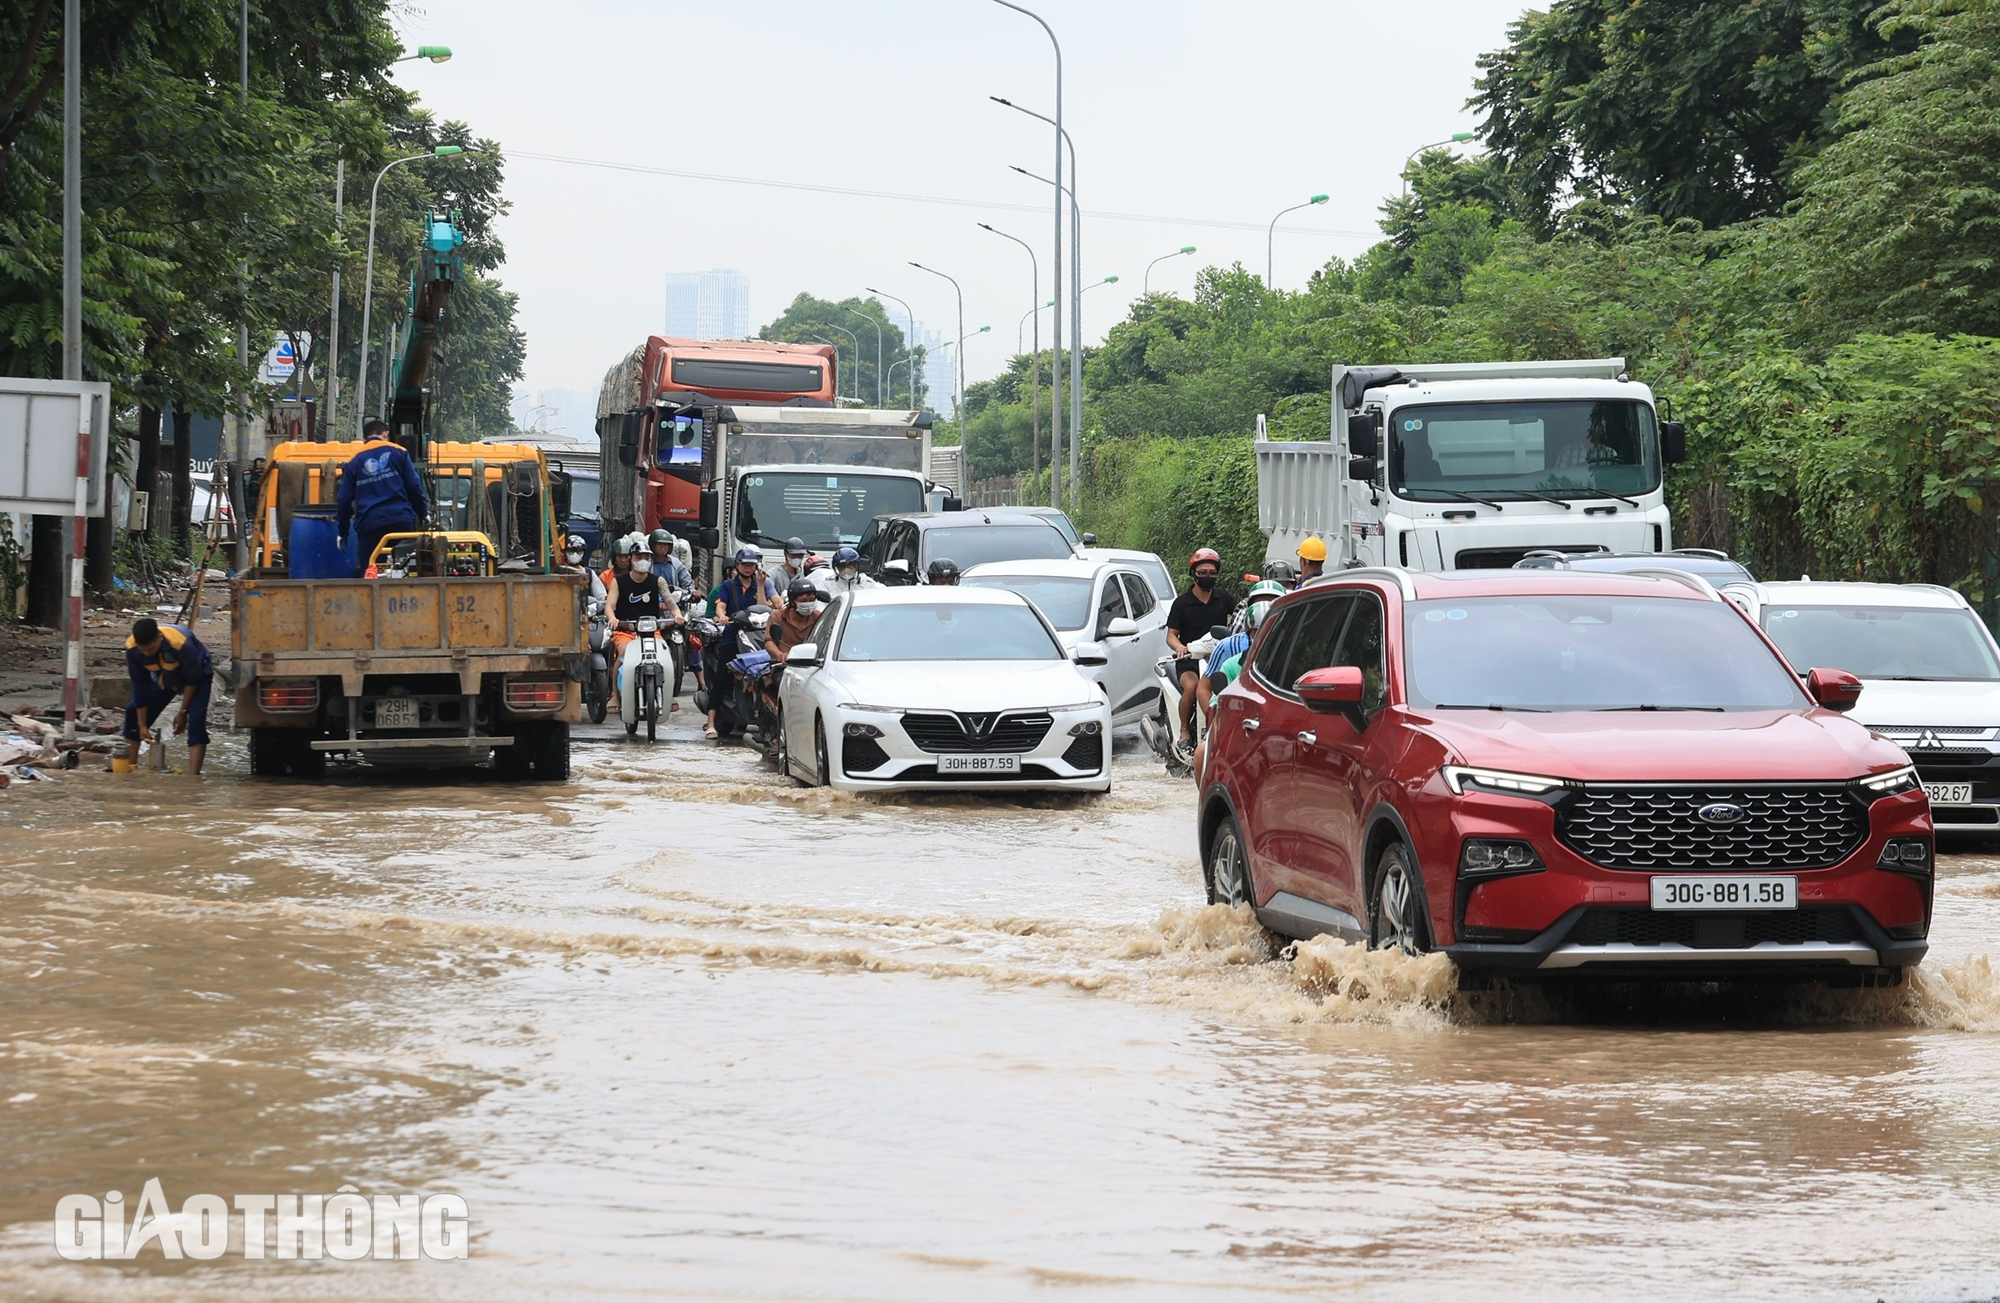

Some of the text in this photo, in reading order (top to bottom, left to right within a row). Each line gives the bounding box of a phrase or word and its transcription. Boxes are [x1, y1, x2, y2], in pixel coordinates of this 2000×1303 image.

[456, 595, 476, 613] 52
[385, 699, 409, 713] 29H
[945, 758, 1013, 769] 30H-887.59
[1709, 806, 1735, 819] Ford
[1665, 883, 1785, 903] 30G-881.58
